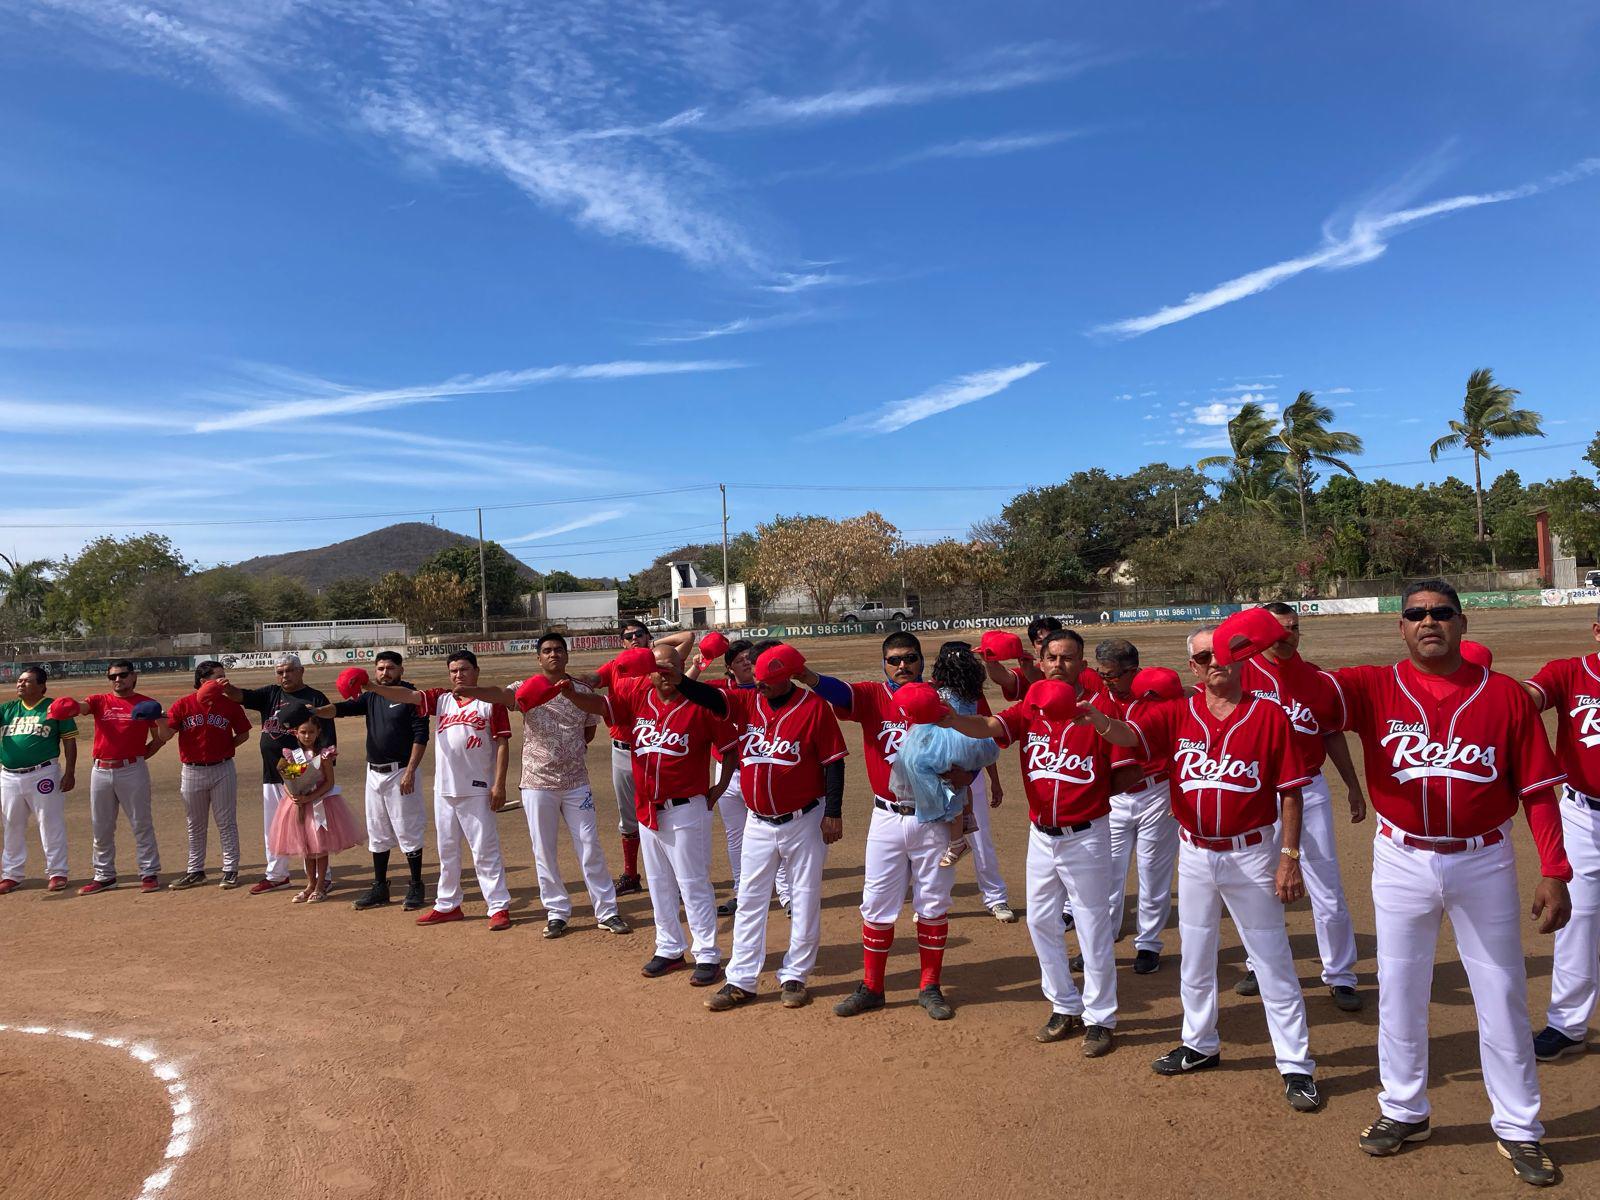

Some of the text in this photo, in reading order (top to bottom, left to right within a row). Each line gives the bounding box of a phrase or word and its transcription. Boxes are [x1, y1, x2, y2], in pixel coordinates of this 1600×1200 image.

[1119, 610, 1137, 618] RADIO
[1155, 609, 1170, 617] TAXI
[900, 620, 939, 632] DISEÑO
[942, 619, 950, 630] Y
[952, 615, 1035, 629] CONSTRUCCION
[741, 628, 769, 638] ECO
[817, 624, 862, 635] 986-11-11
[472, 641, 506, 653] HERRERA
[240, 652, 272, 660] PANTERA
[1251, 690, 1278, 700] Taxis
[635, 717, 656, 727] Taxis
[881, 720, 906, 731] Taxis
[1386, 719, 1425, 734] Taxis
[0, 723, 51, 738] VERDES
[632, 725, 689, 751] Rojos
[738, 731, 801, 758] Rojos
[1026, 732, 1051, 744] Taxis
[1177, 738, 1206, 751] Taxis
[1023, 742, 1095, 772] Rojos
[1380, 732, 1496, 768] Rojos
[1173, 749, 1260, 782] Rojos
